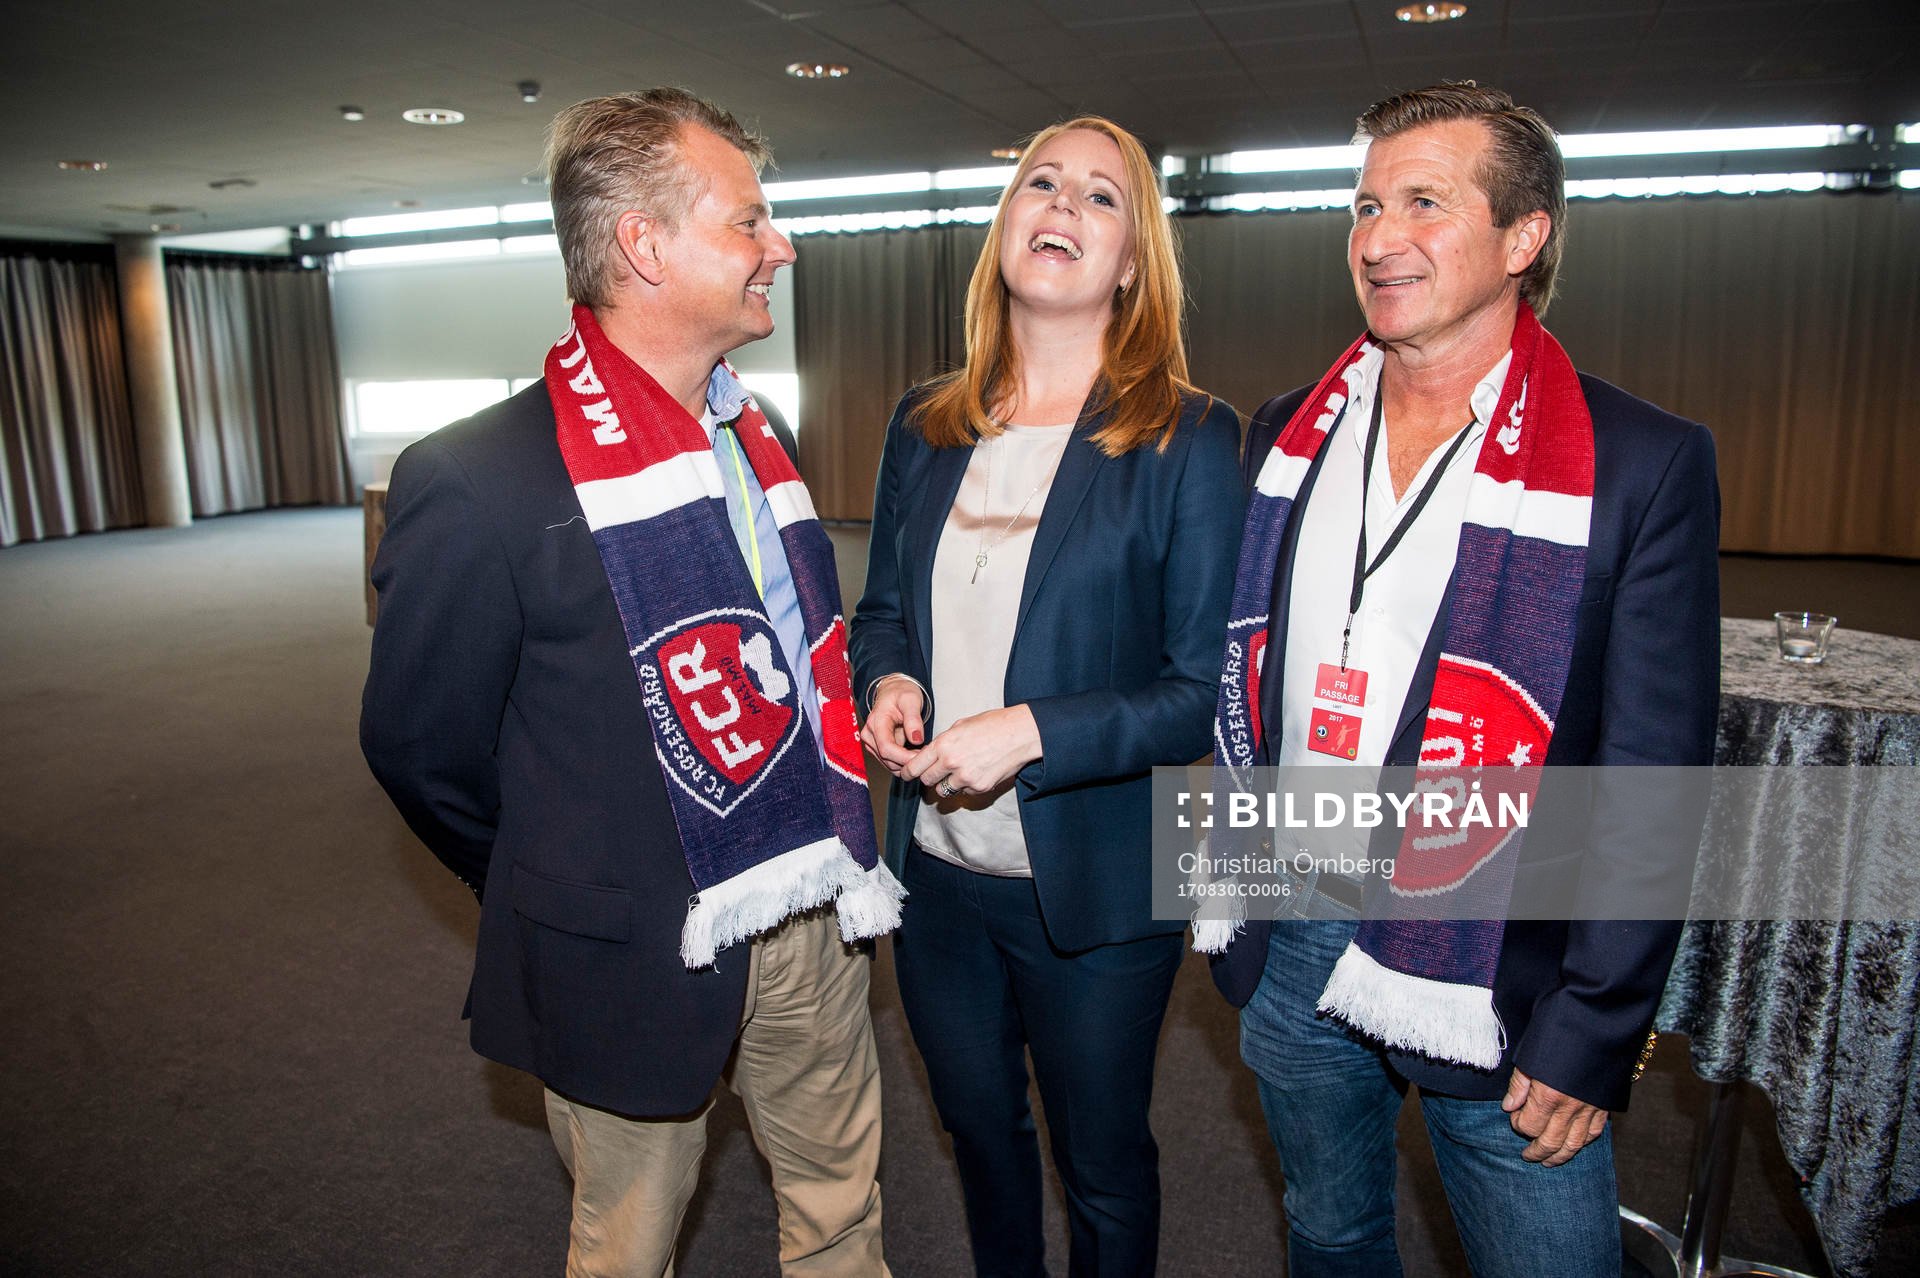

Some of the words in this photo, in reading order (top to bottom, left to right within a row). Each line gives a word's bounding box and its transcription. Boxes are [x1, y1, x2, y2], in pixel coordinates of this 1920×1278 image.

[719, 656, 762, 715] MALMÖ
[1320, 688, 1359, 704] PASSAGE
[1335, 681, 1348, 690] FRI
[667, 638, 765, 769] FCR
[639, 663, 710, 785] ROSENGÅRD
[1329, 714, 1343, 722] 2017
[704, 774, 727, 801] FC
